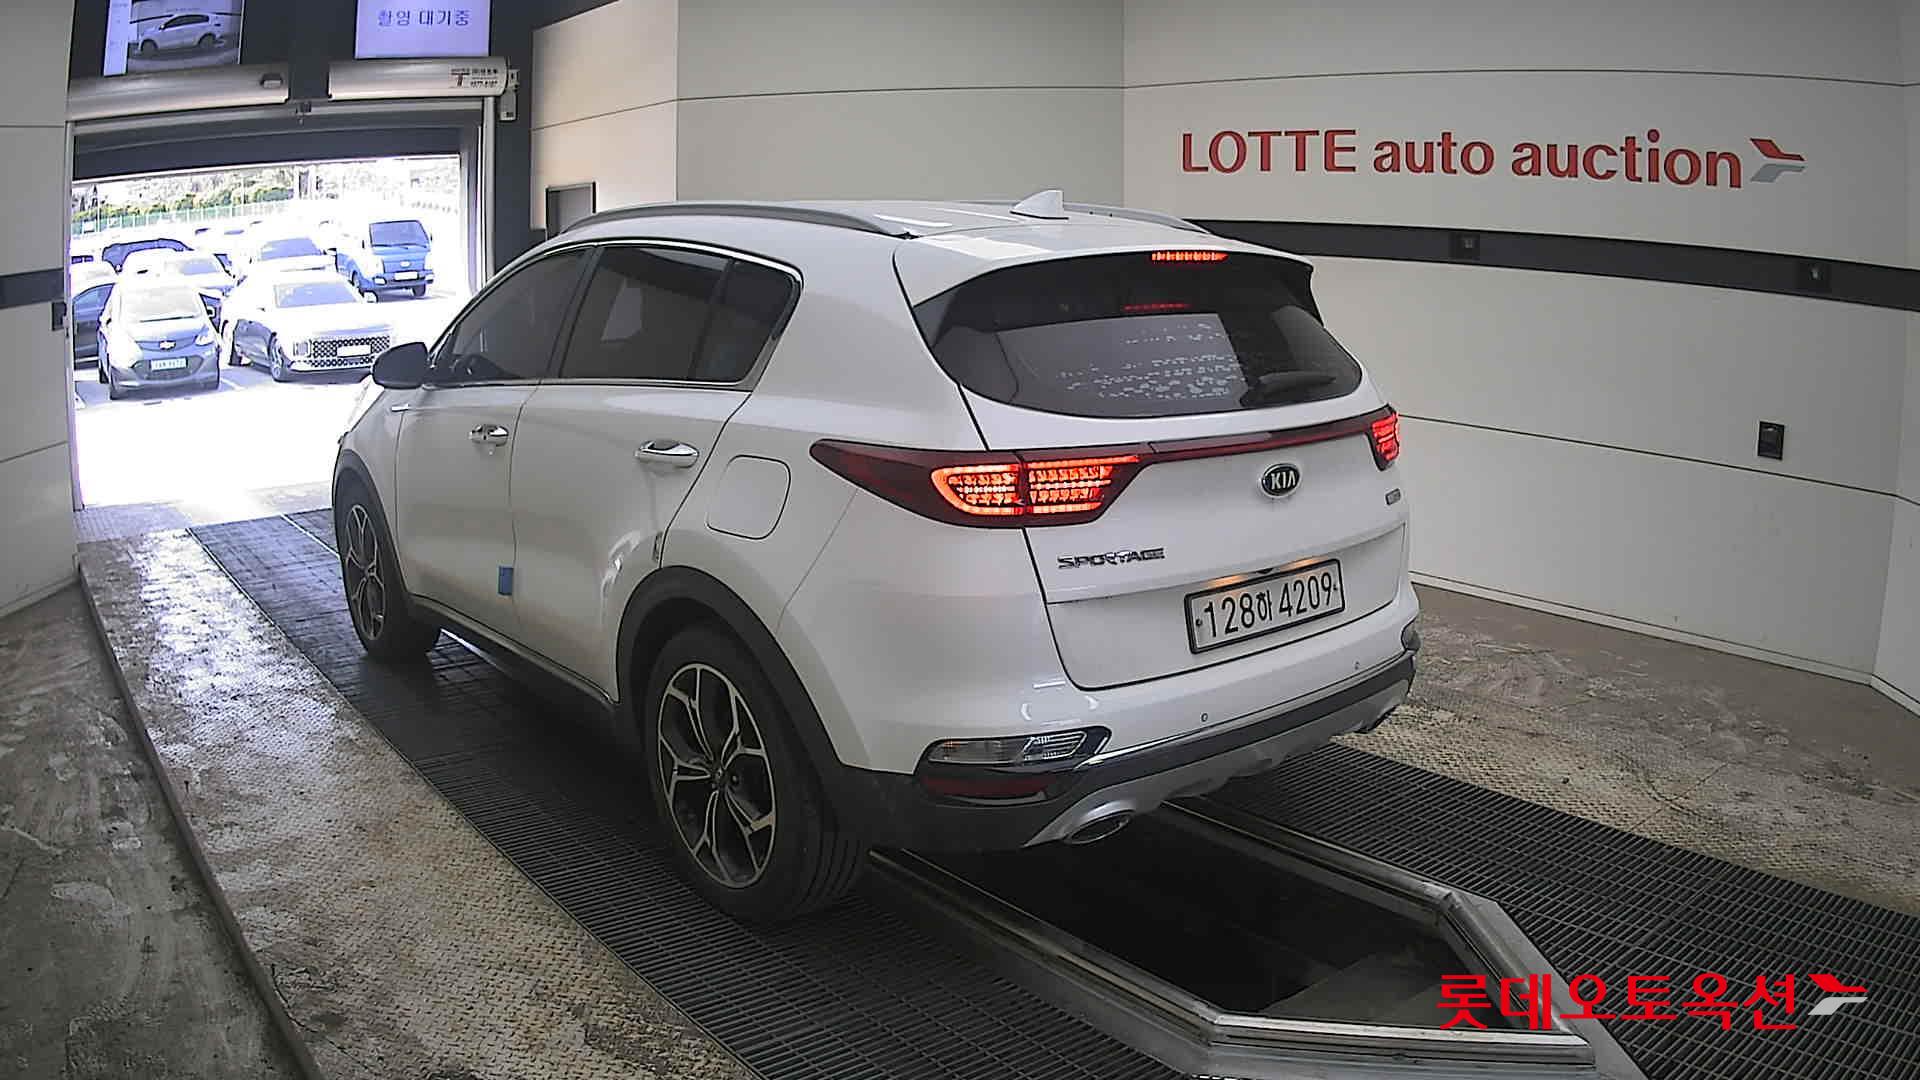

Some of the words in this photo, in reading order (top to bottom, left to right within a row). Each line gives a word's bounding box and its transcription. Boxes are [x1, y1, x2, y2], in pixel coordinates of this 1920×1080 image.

[419, 10, 469, 26] 대기중
[1182, 130, 1358, 174] LOTTE
[1373, 132, 1495, 176] auto
[1511, 128, 1742, 188] auction
[1270, 470, 1297, 491] KIA
[1057, 547, 1165, 569] SPORTAGE
[1204, 588, 1273, 637] 128하
[1279, 572, 1333, 617] 4209
